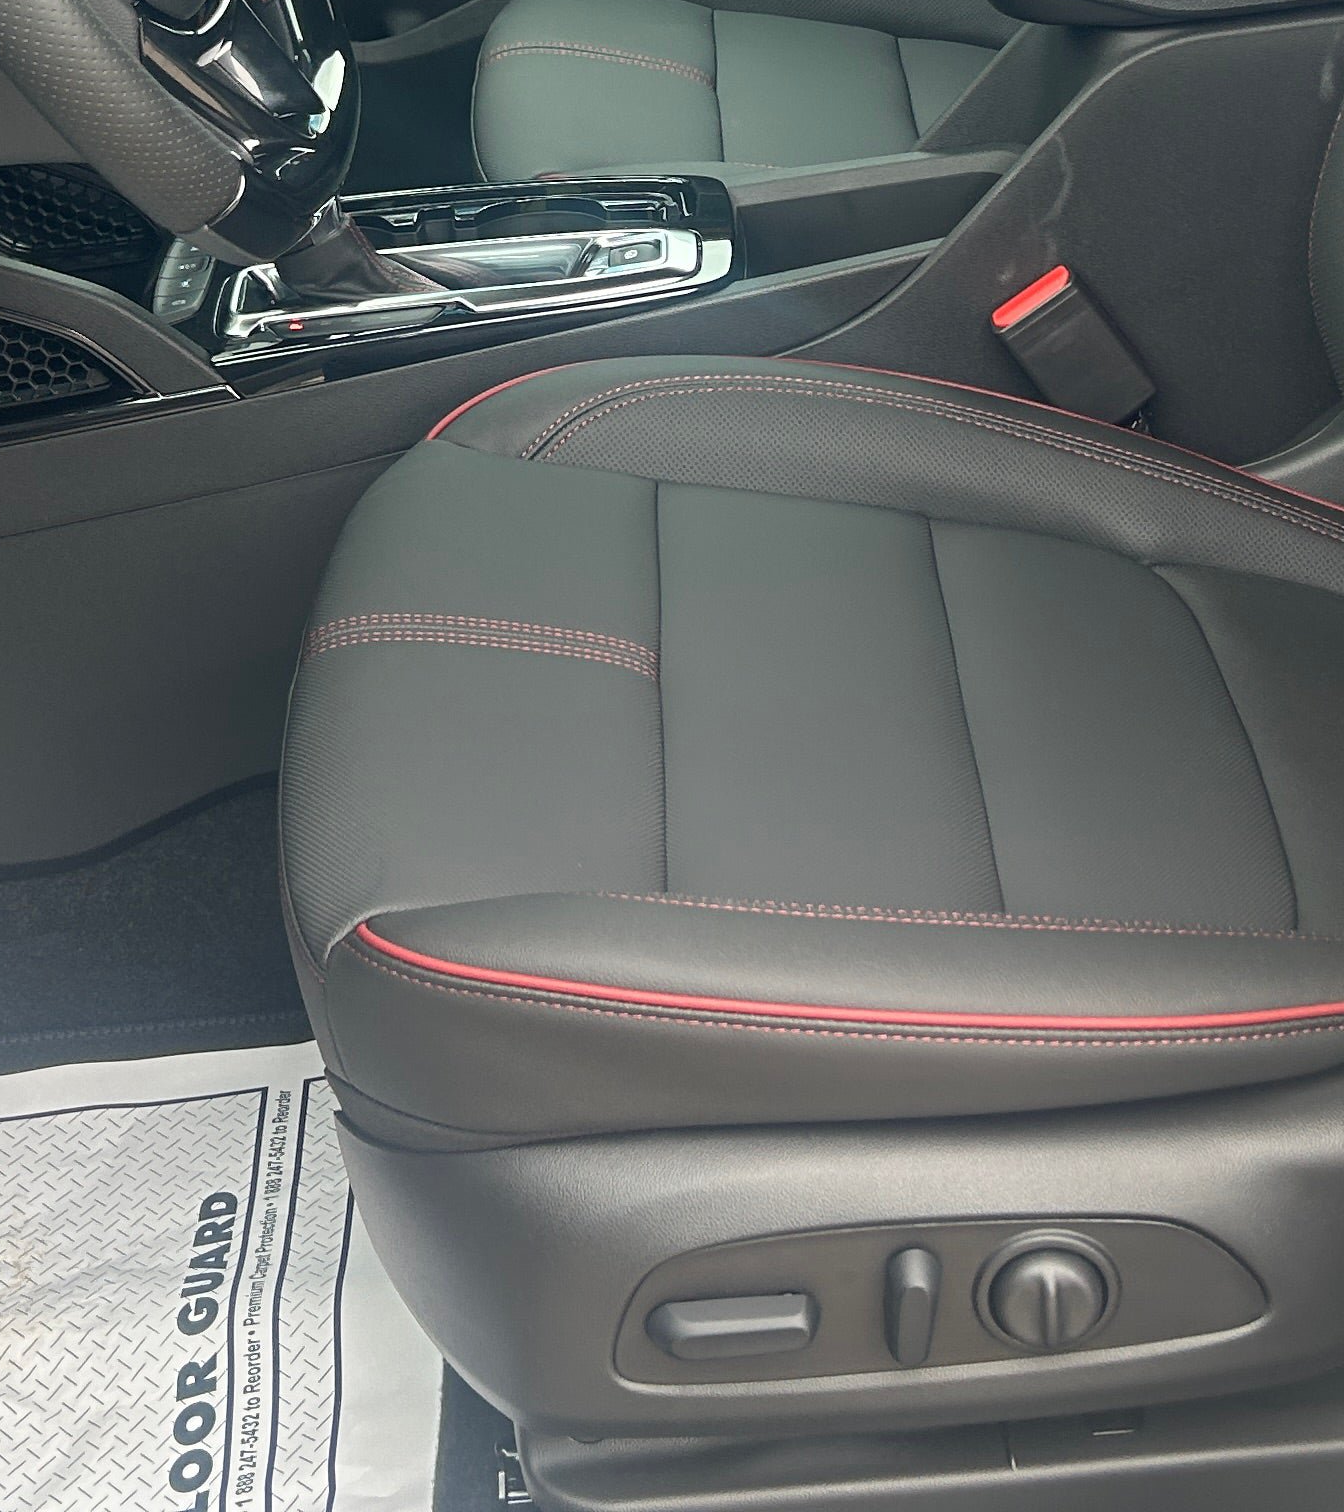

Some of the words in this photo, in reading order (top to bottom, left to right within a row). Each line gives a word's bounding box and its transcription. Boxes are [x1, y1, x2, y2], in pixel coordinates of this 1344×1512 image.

[272, 1090, 291, 1124] Reorder
[273, 1124, 287, 1136] to
[257, 1208, 278, 1253] Protection
[177, 1191, 238, 1336] GUARD
[249, 1247, 272, 1280] Carpet
[243, 1279, 265, 1328] Premium
[243, 1340, 261, 1395] Reorder
[247, 1396, 261, 1412] to
[238, 1413, 260, 1470] 247-5432
[235, 1472, 255, 1495] 888
